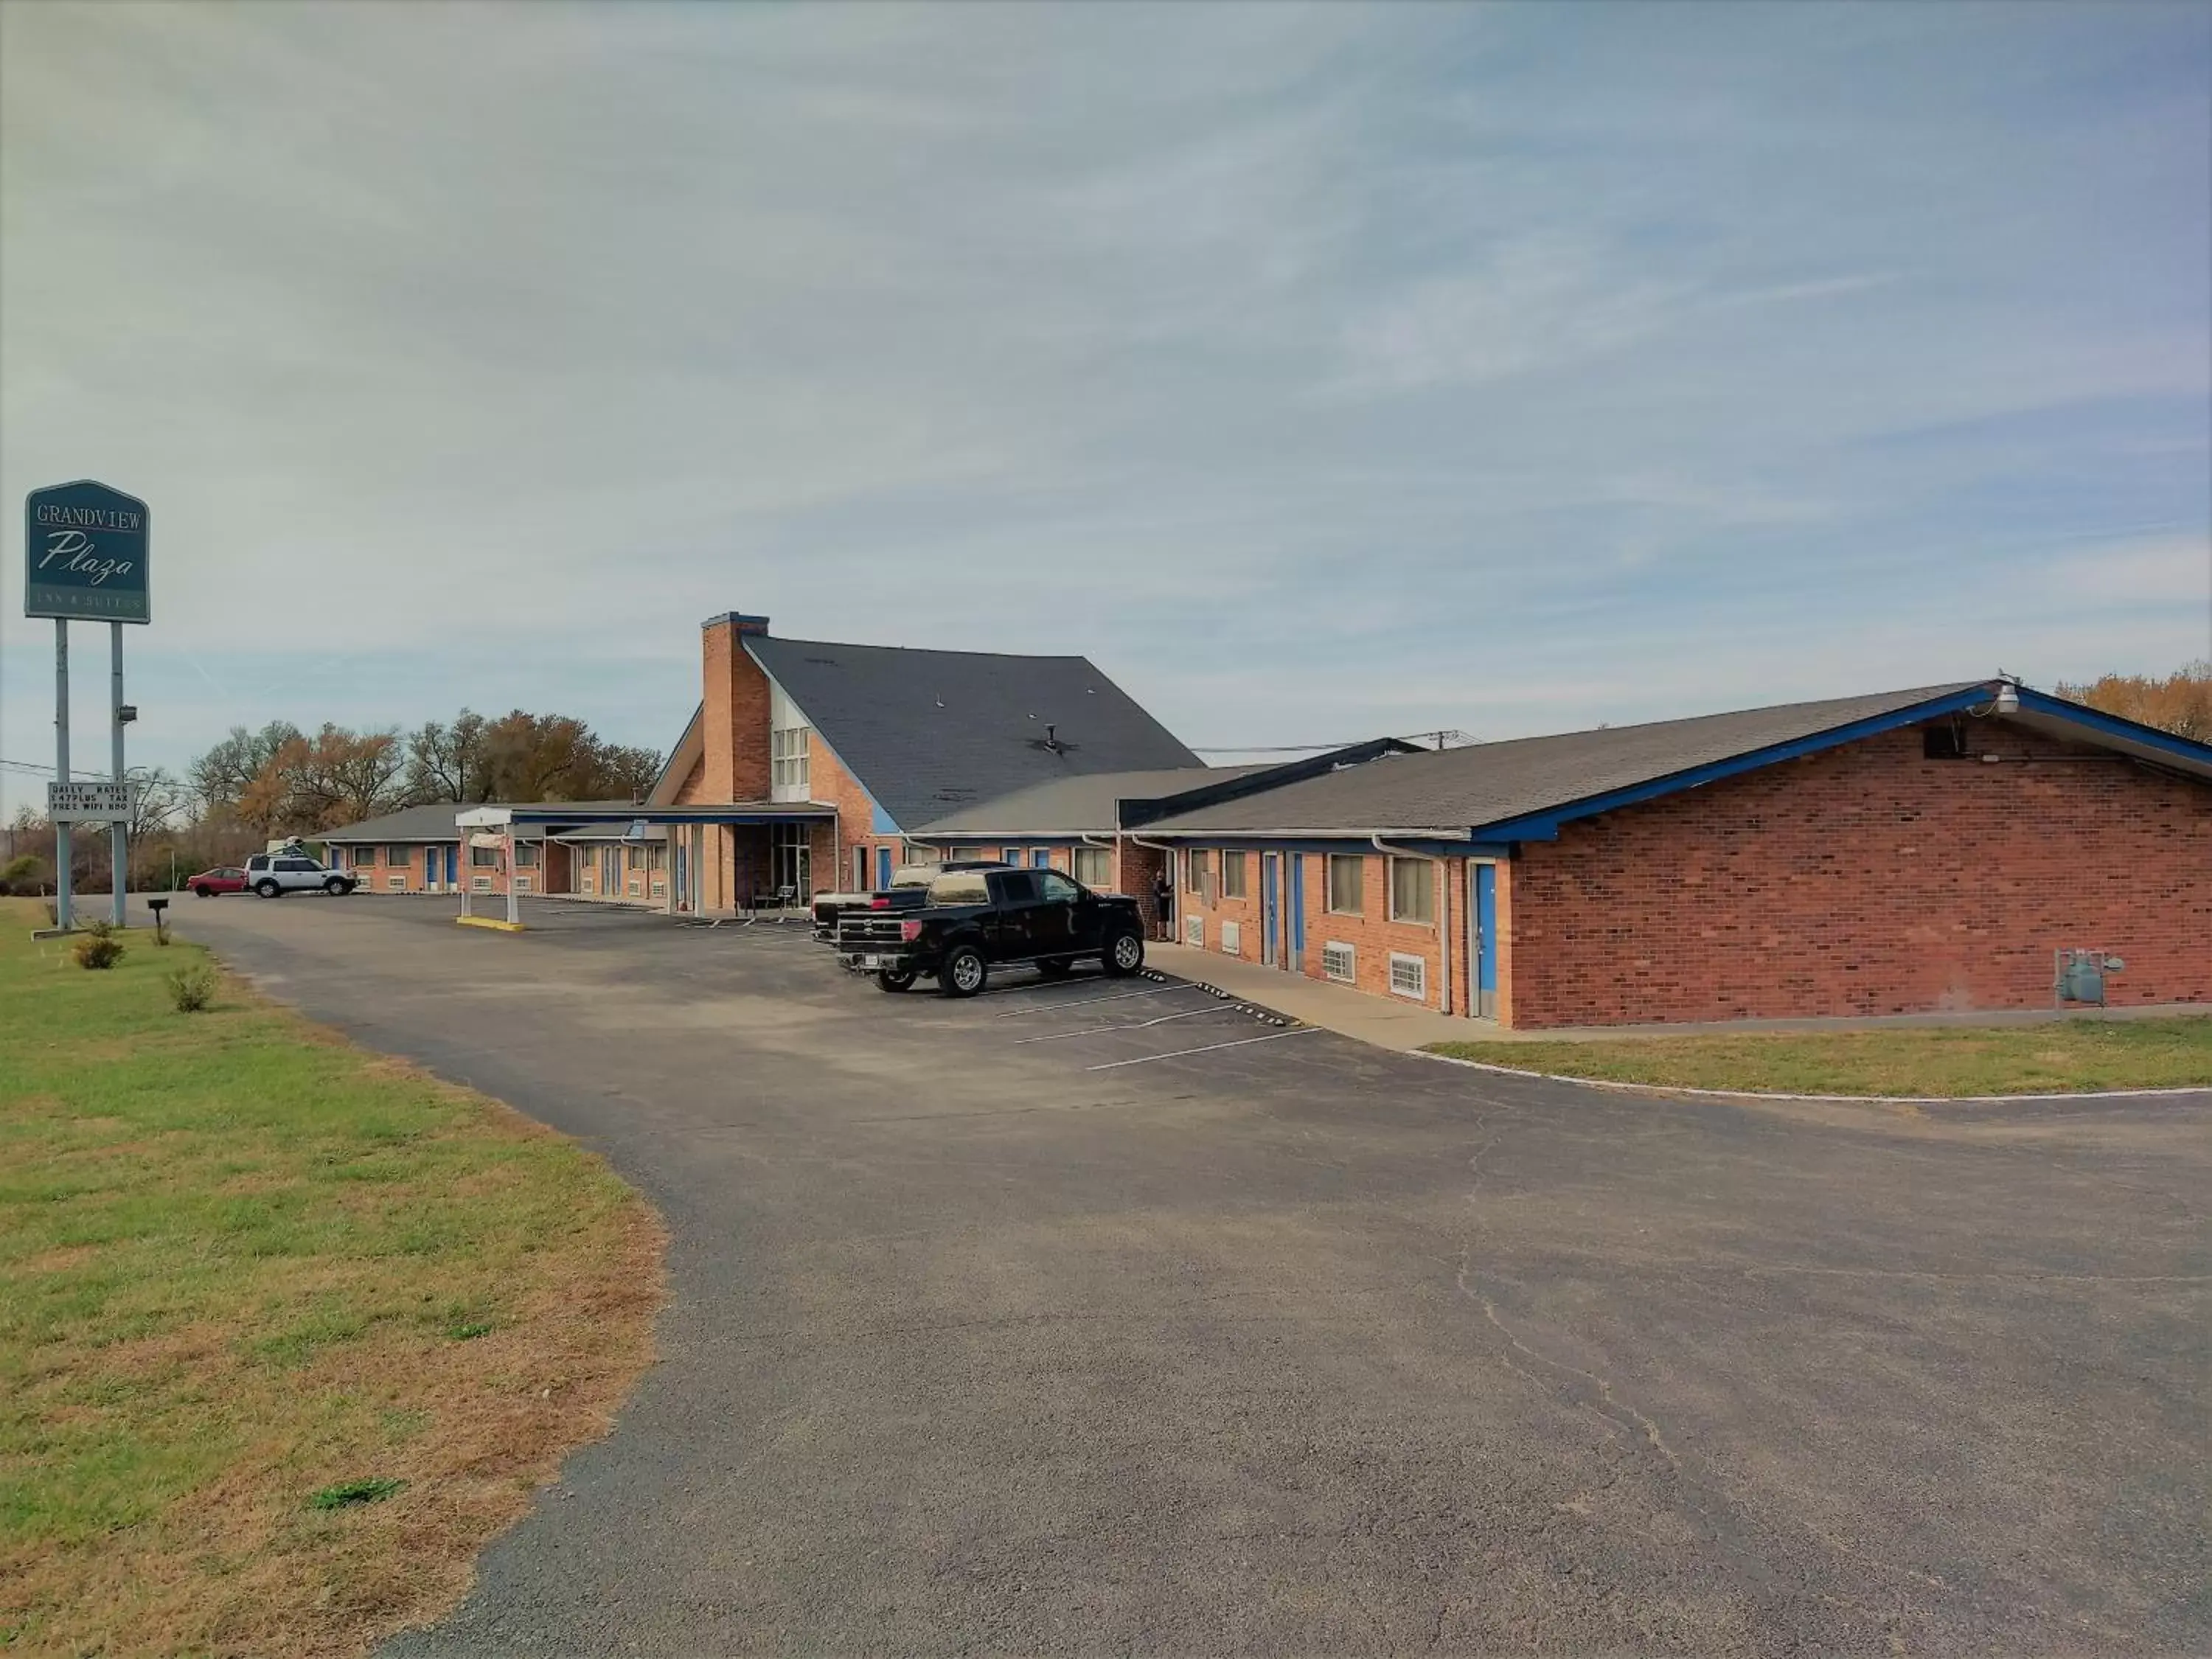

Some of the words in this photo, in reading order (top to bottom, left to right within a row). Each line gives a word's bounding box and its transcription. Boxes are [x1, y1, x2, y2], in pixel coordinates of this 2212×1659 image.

[38, 504, 140, 529] GRANDVIEW
[38, 530, 133, 585] Plaza
[83, 596, 140, 609] SUIT
